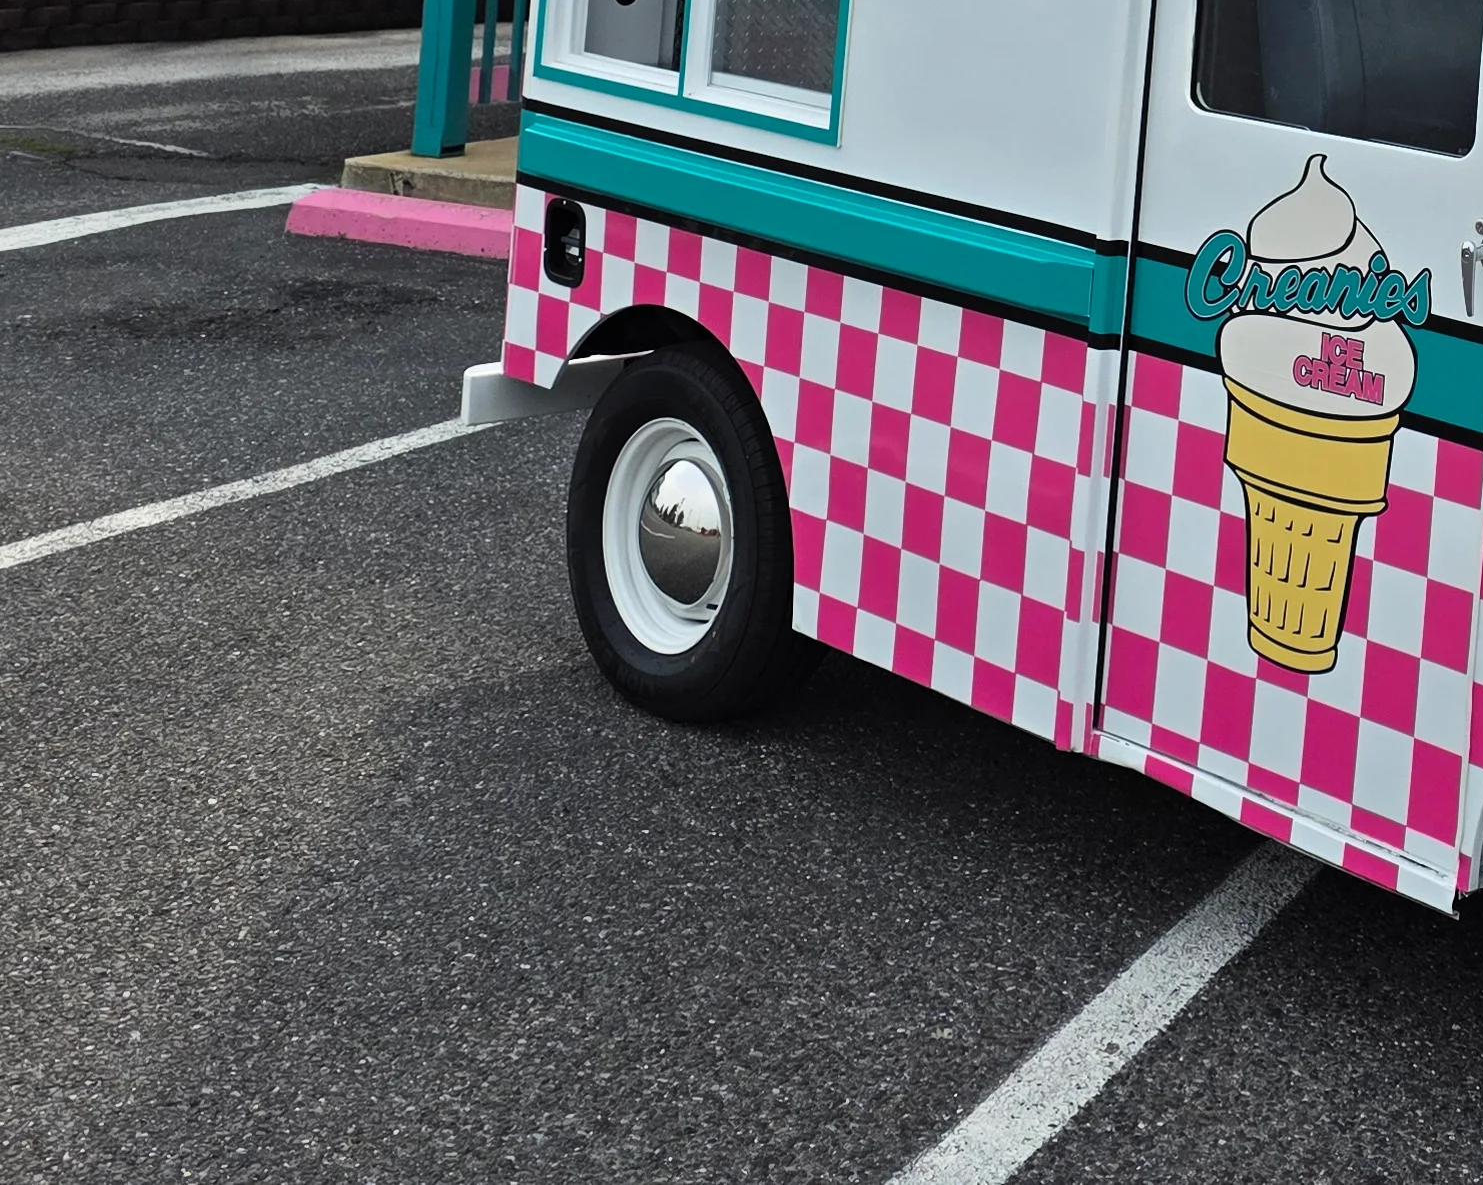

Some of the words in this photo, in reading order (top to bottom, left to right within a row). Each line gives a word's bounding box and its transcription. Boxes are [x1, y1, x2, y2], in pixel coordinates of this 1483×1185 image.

[1184, 229, 1432, 328] Creanies
[1320, 332, 1364, 371] ICE
[1293, 355, 1385, 406] CREAM
